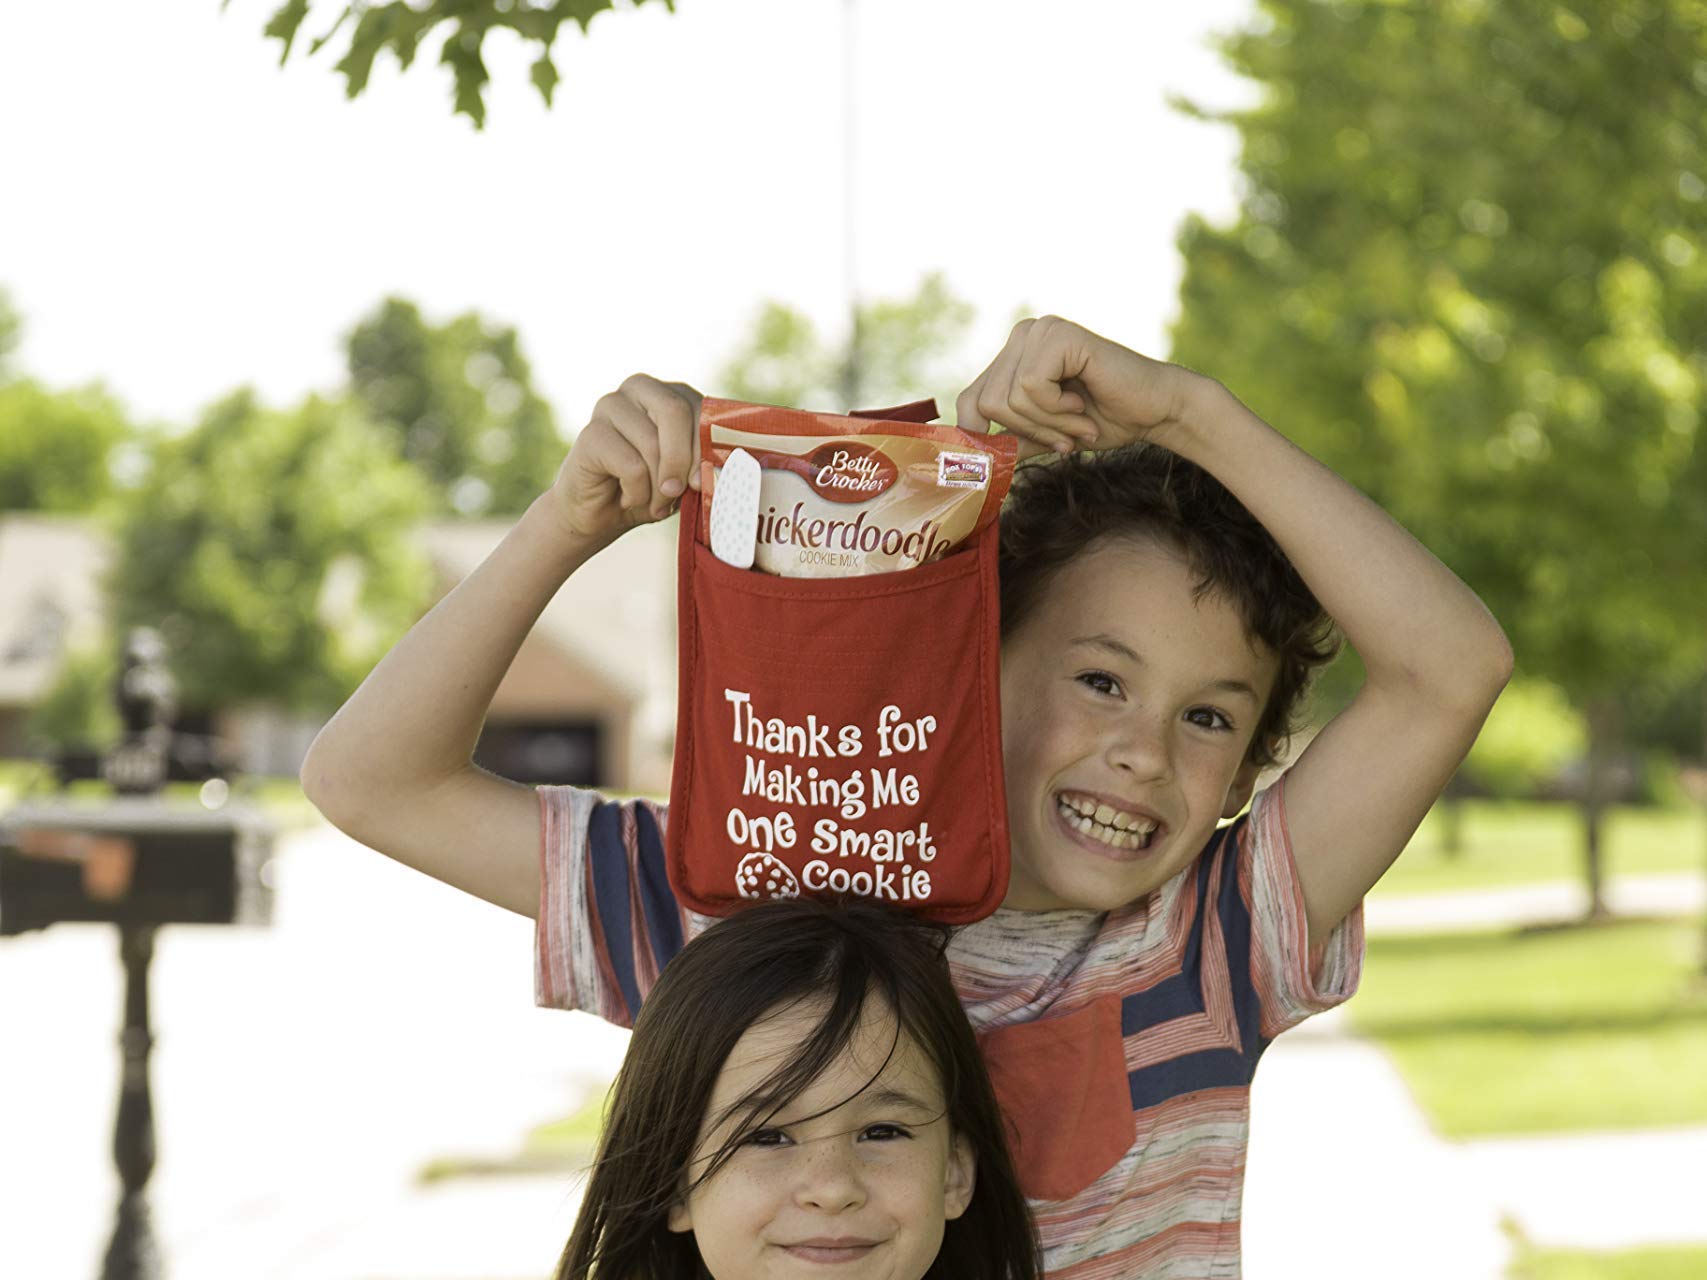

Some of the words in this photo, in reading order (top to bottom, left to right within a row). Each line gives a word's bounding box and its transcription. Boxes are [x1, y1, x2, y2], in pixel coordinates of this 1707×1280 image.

[815, 464, 884, 492] Crocker
[832, 450, 880, 480] Betty
[799, 550, 838, 566] COOKIE
[839, 553, 860, 568] MIX
[724, 688, 862, 758] Thanks
[877, 705, 937, 757] for
[742, 755, 866, 820] Making
[871, 768, 920, 809] Me
[726, 808, 797, 852] One
[810, 819, 937, 862] Smart
[802, 860, 932, 901] Cookie
